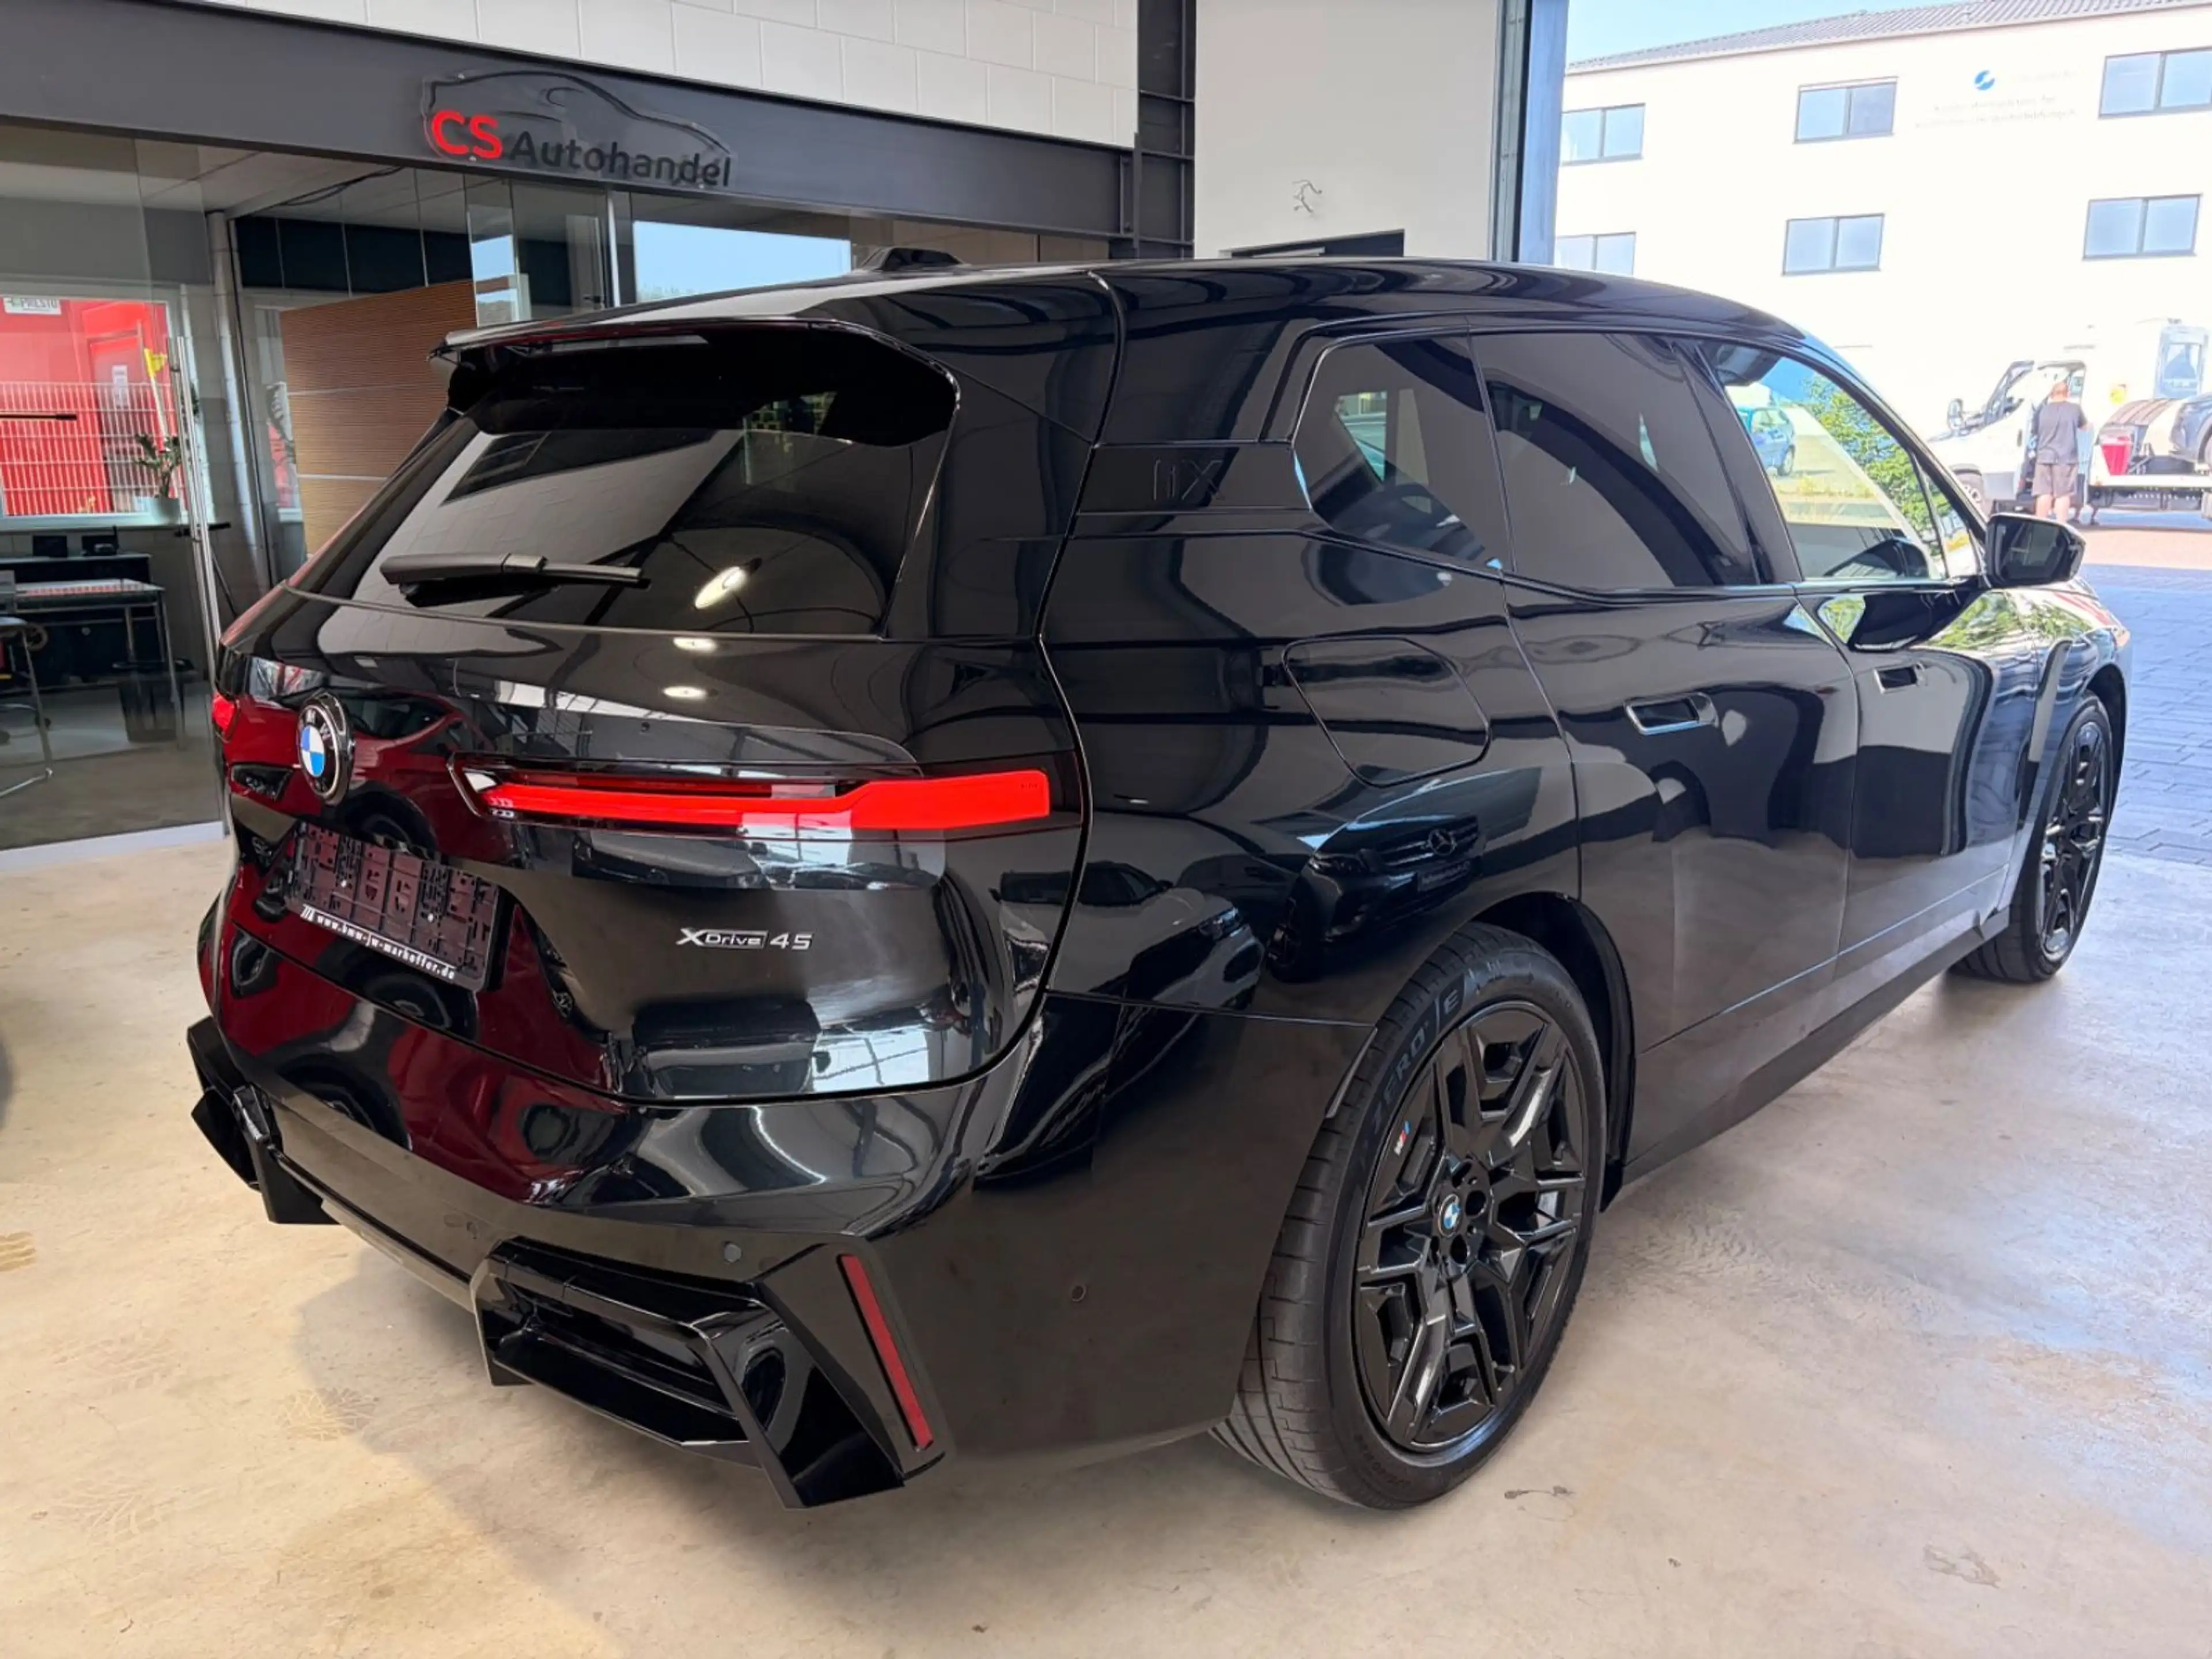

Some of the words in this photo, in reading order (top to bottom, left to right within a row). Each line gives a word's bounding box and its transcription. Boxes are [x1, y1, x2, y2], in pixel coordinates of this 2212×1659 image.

[431, 110, 503, 159] CS
[510, 131, 731, 187] Autohandel
[770, 932, 815, 950] 45
